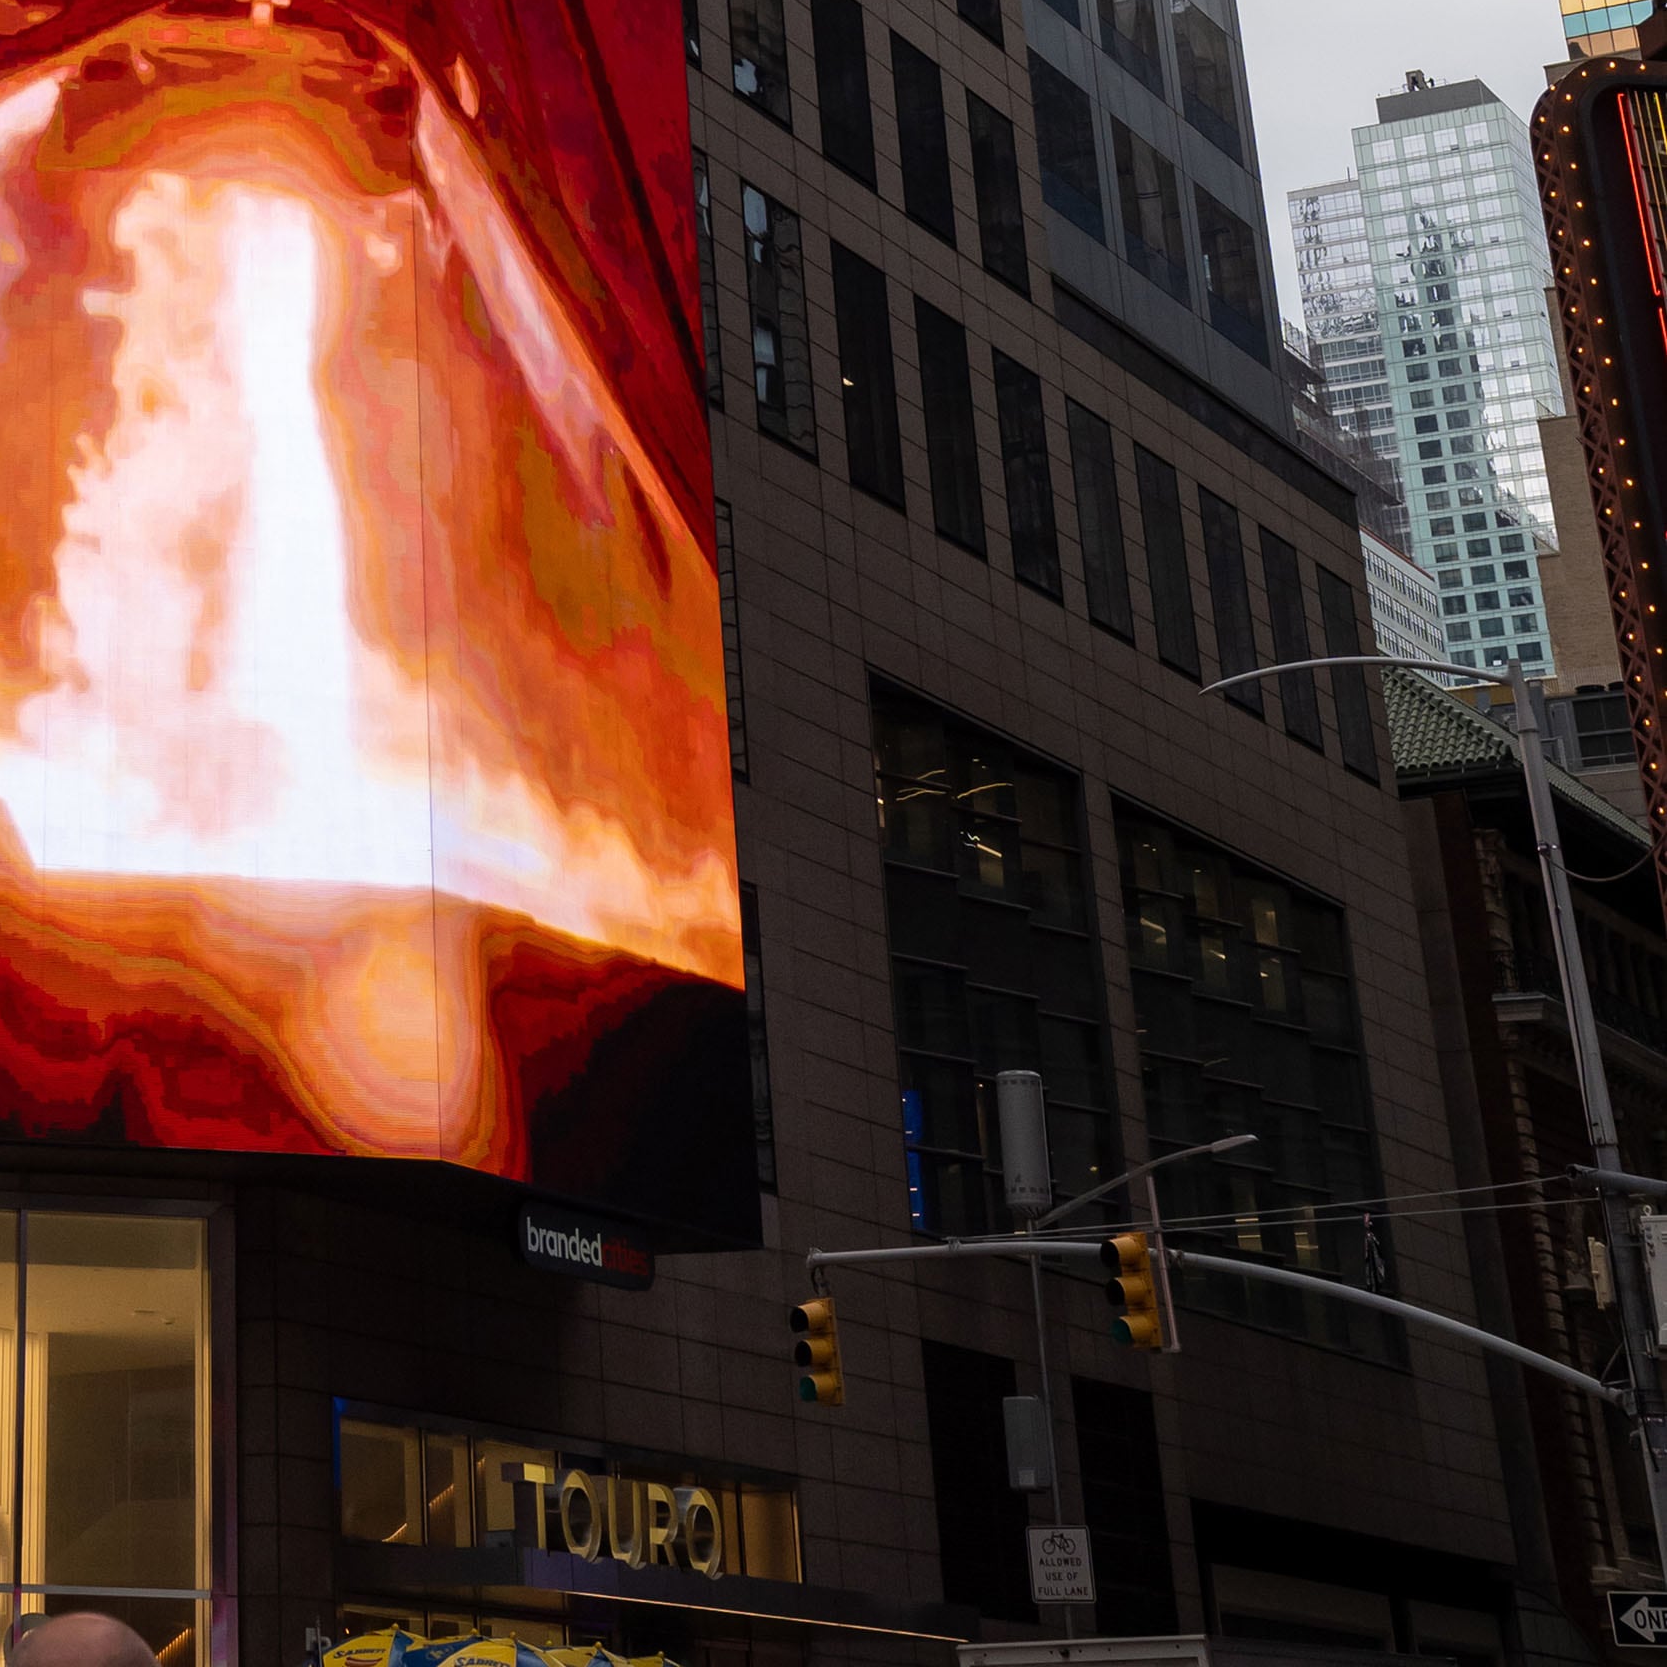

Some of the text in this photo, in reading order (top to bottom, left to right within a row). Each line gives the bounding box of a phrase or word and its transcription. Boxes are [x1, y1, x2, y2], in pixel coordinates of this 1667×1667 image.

[502, 1463, 725, 1580] TOURO
[1038, 1557, 1082, 1567] ALLOWED
[1045, 1571, 1079, 1581] USE OF
[1037, 1586, 1089, 1596] FULL LANE
